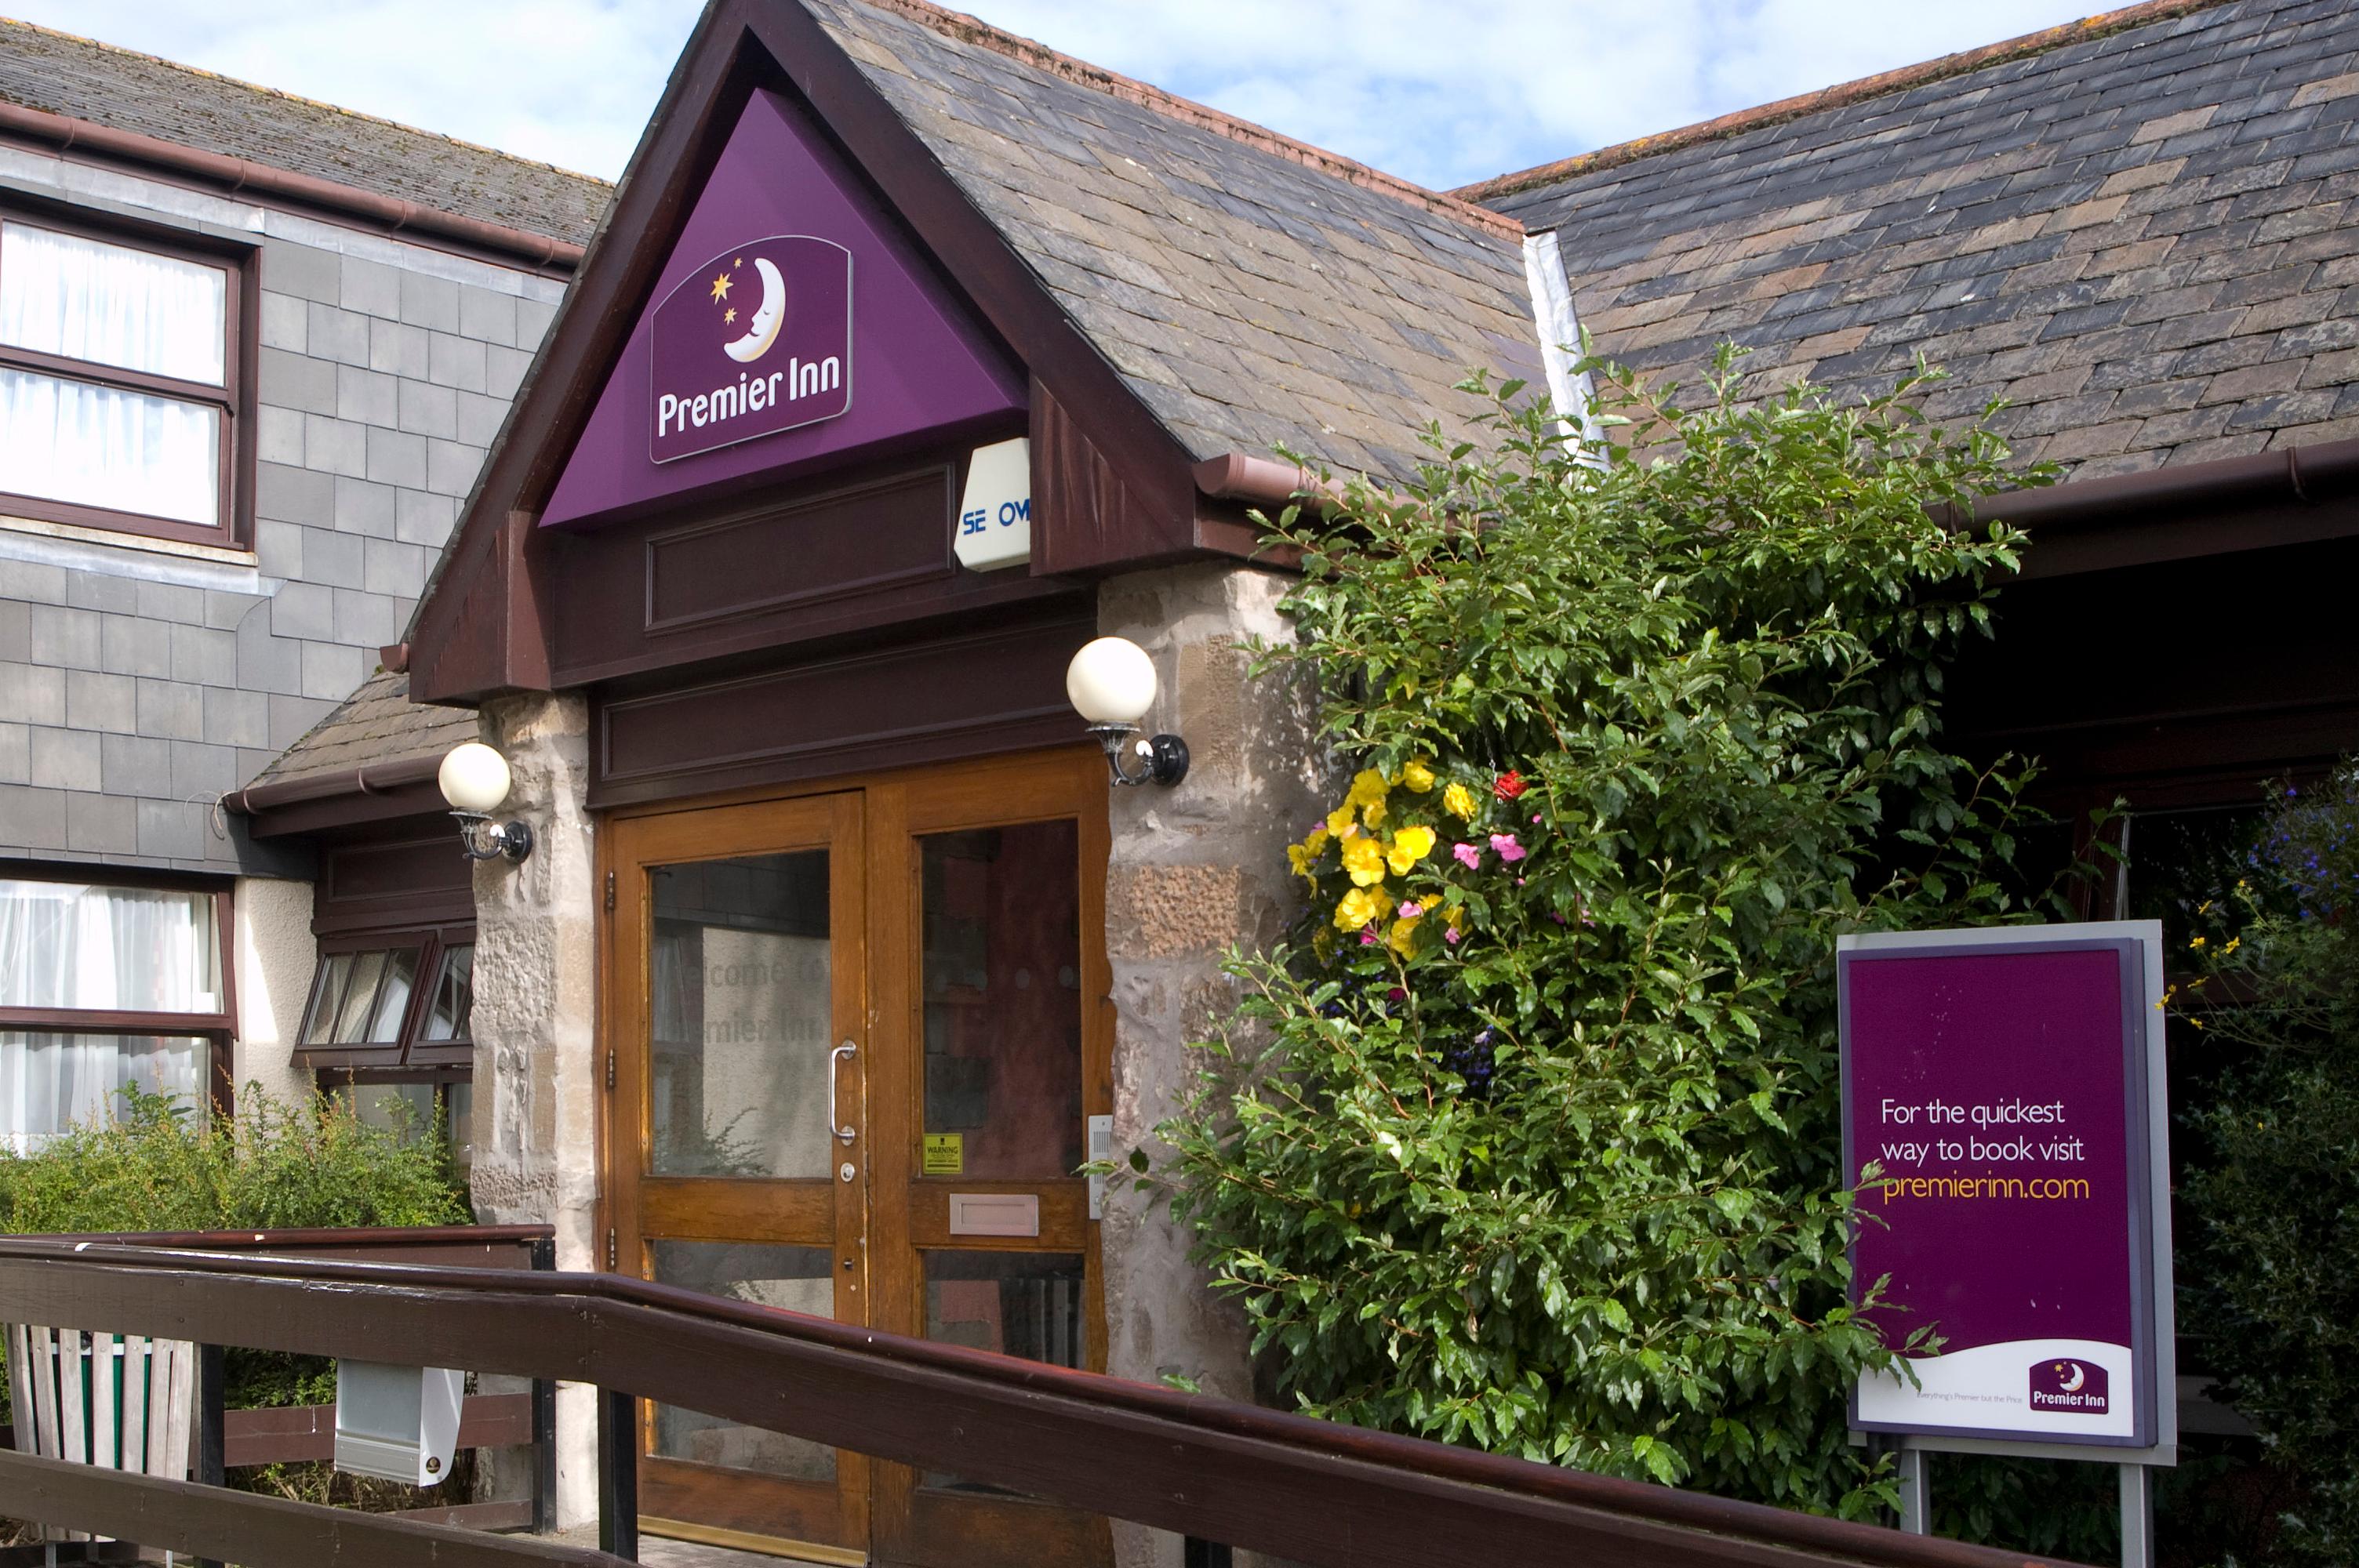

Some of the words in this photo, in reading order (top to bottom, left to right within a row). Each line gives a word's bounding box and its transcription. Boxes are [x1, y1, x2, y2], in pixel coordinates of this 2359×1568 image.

[658, 372, 783, 437] Premier
[789, 356, 840, 401] Inn
[963, 509, 986, 535] SE
[1881, 1098, 1921, 1124] For
[1925, 1098, 1965, 1123] the
[1971, 1097, 2066, 1131] quickest
[926, 1145, 958, 1154] WARNING
[1881, 1142, 1930, 1168] way
[1936, 1138, 1964, 1161] to
[1969, 1134, 2035, 1161] book
[2038, 1134, 2085, 1161] visit
[1883, 1169, 2090, 1206] premierinn.com
[1954, 1392, 1979, 1401] Premier
[1981, 1394, 1992, 1403] but
[1994, 1394, 2005, 1403] the
[2034, 1390, 2084, 1406] Premier
[2085, 1393, 2105, 1407] Inn
